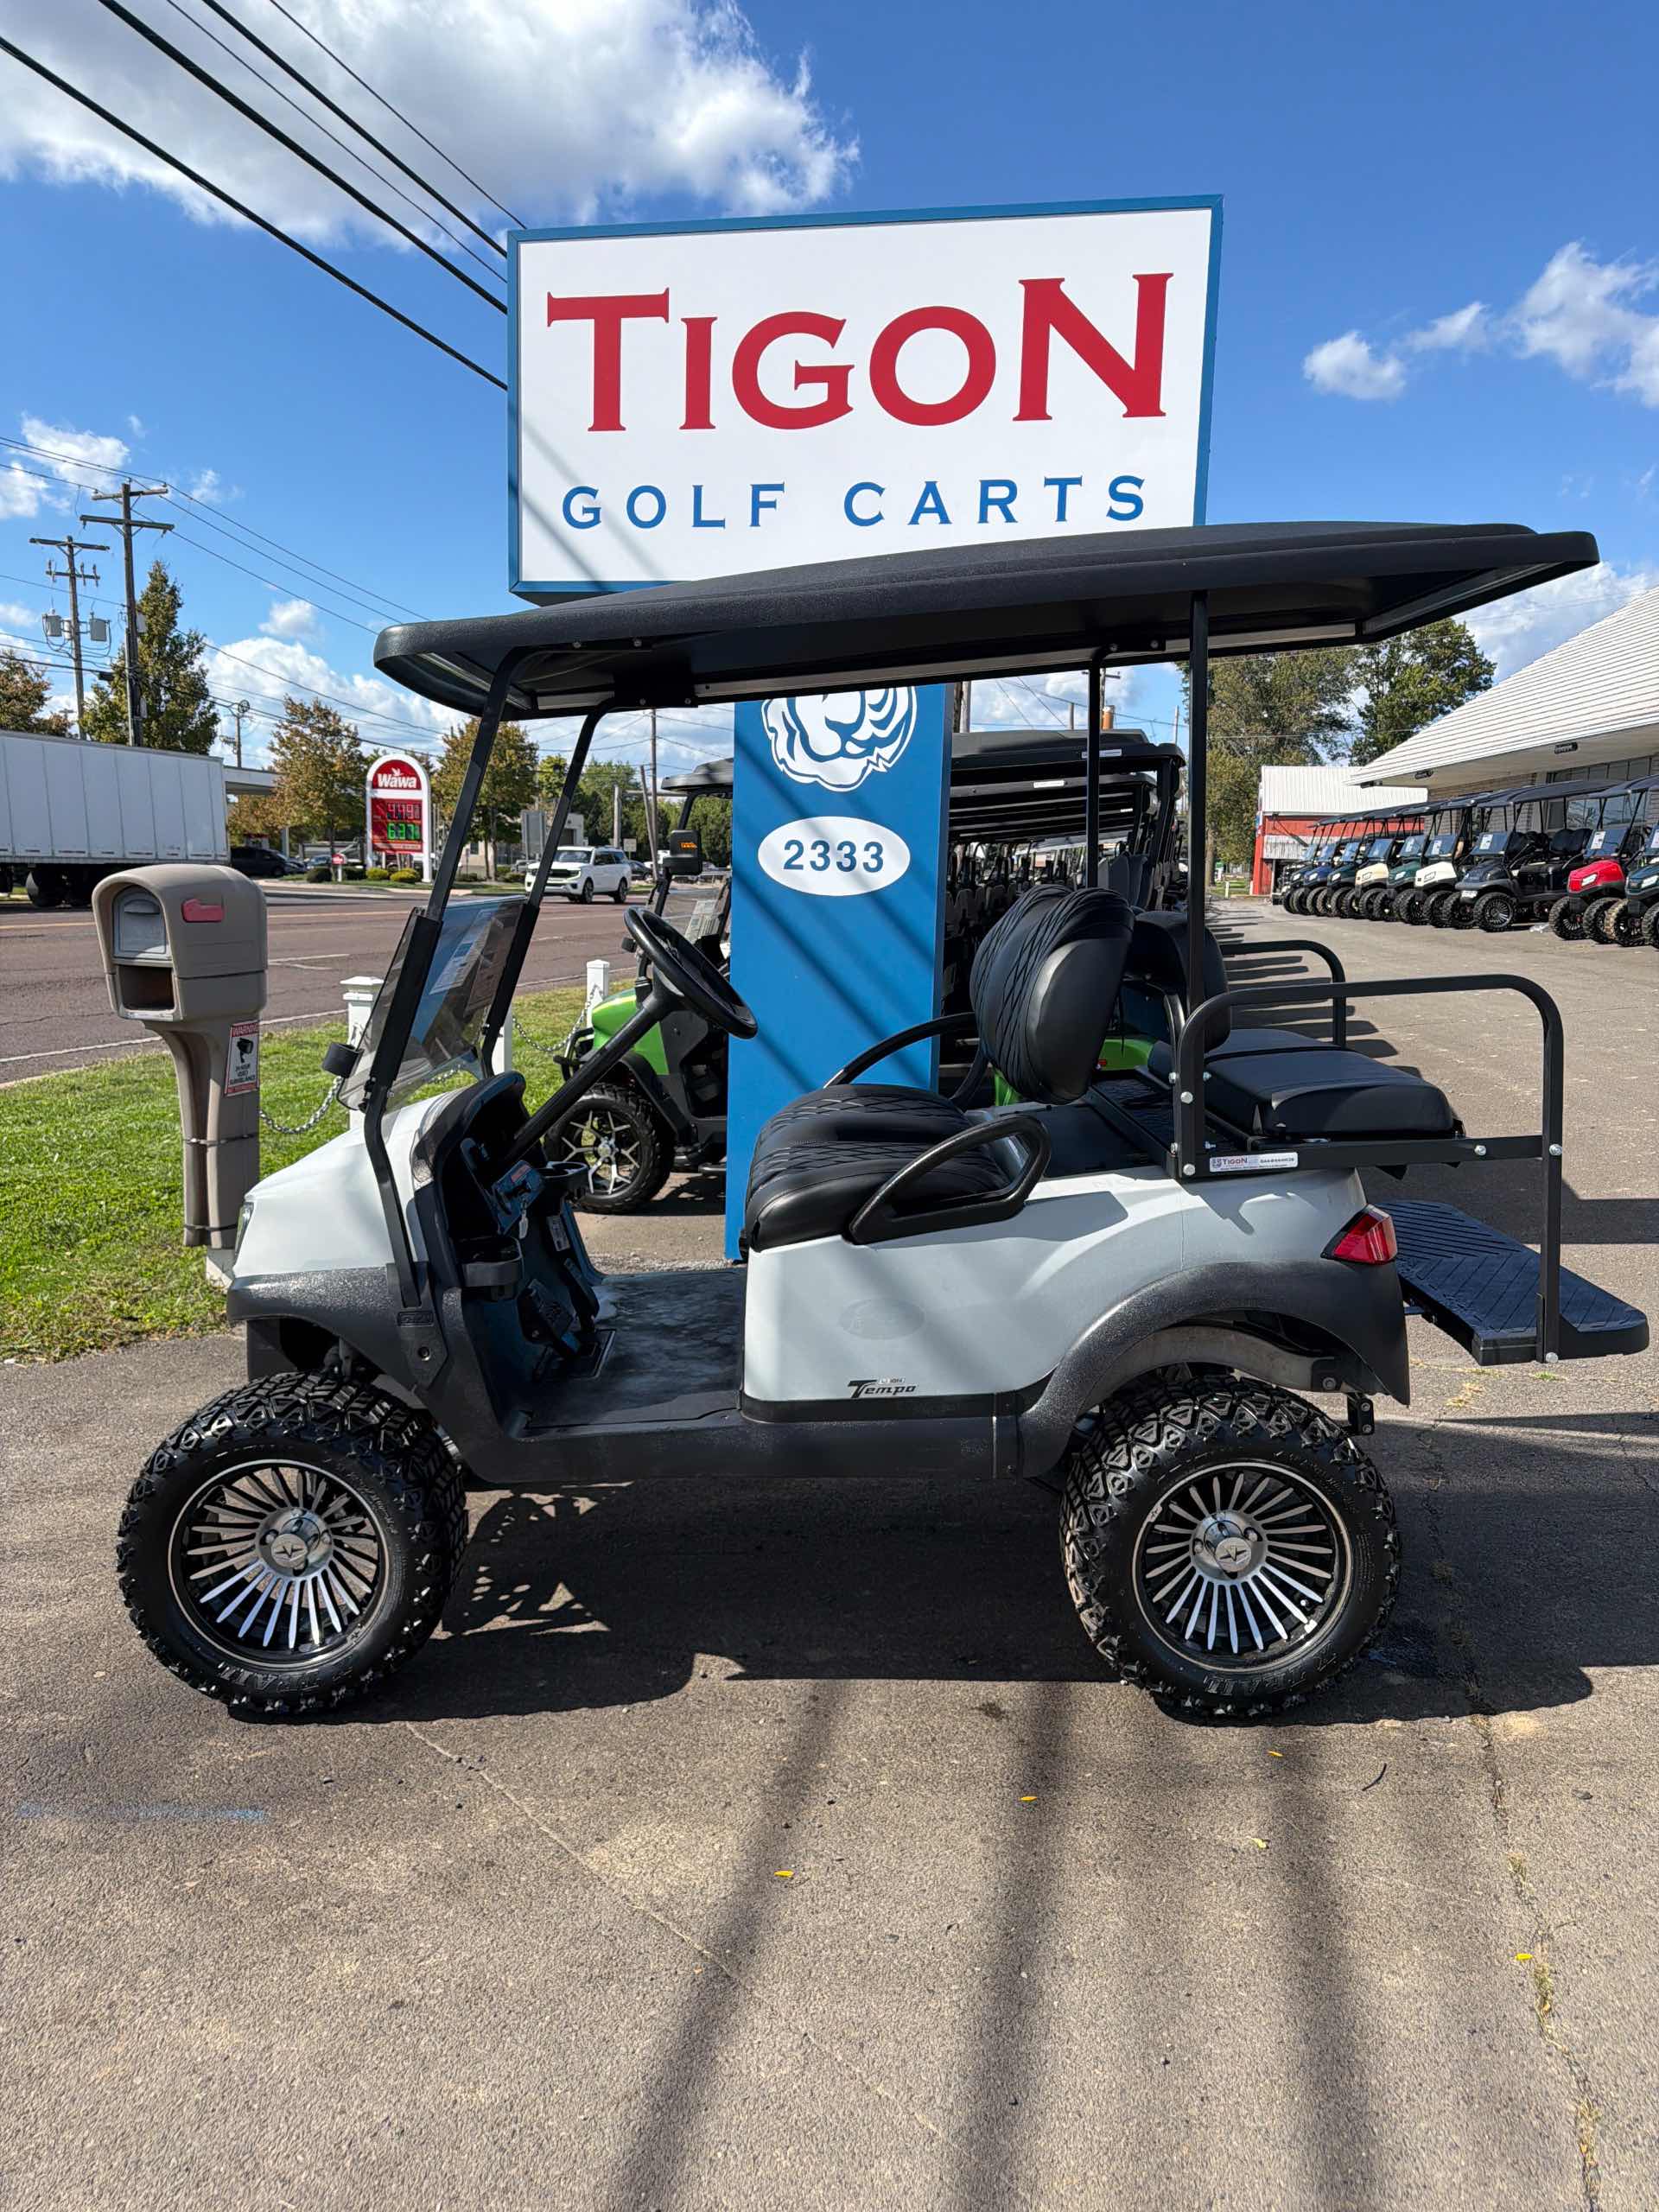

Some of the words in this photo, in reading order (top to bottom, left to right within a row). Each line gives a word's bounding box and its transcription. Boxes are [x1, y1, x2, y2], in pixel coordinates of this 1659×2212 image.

[547, 273, 1173, 431] TIGON
[562, 481, 785, 529] GOLF
[843, 475, 1144, 526] CARTS
[378, 773, 416, 789] Wawa
[784, 839, 883, 873] 2333
[848, 1379, 917, 1399] Tempo
